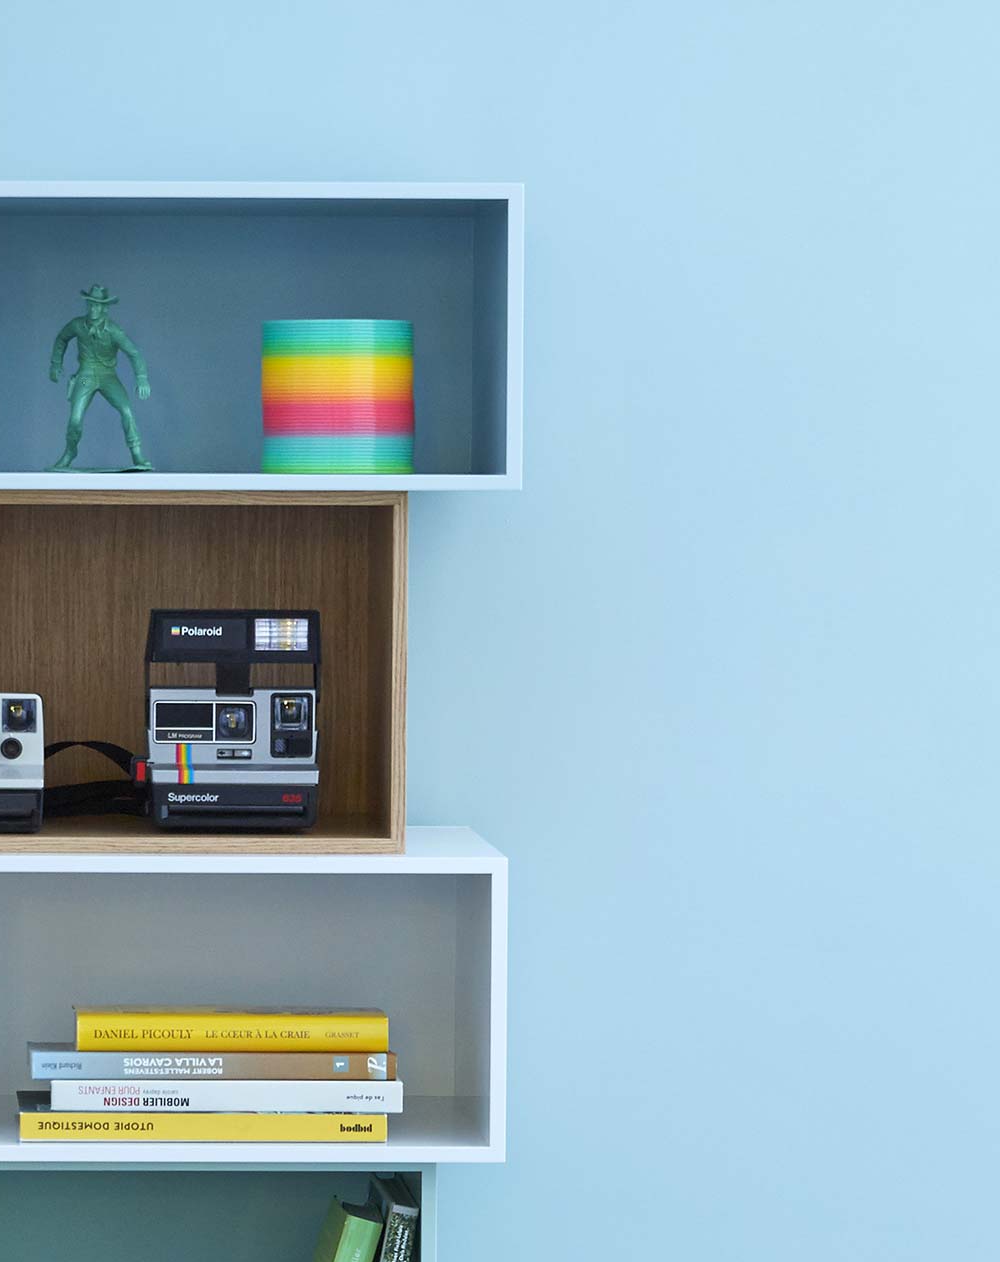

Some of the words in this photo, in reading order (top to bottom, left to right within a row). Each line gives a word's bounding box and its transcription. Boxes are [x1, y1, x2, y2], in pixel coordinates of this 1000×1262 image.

[181, 626, 223, 637] Polaroid
[168, 793, 219, 803] Supercolor
[93, 1029, 138, 1039] DANIEL
[142, 1029, 192, 1039] PICOULY
[205, 1029, 217, 1039] LE
[221, 1030, 252, 1039] CŒUR
[255, 1028, 262, 1039] À
[264, 1029, 277, 1039] LA
[280, 1029, 310, 1039] CRAIE
[123, 1057, 172, 1066] CAVROIS
[175, 1057, 206, 1066] VILLA
[208, 1057, 223, 1066] LA
[78, 1086, 116, 1094] ENFANTS
[118, 1086, 141, 1094] POUR
[103, 1098, 140, 1106] DESIGN
[142, 1098, 190, 1106] MOBILIER
[38, 1121, 109, 1131] DOMESTIQUE
[114, 1122, 154, 1130] UTOPIE
